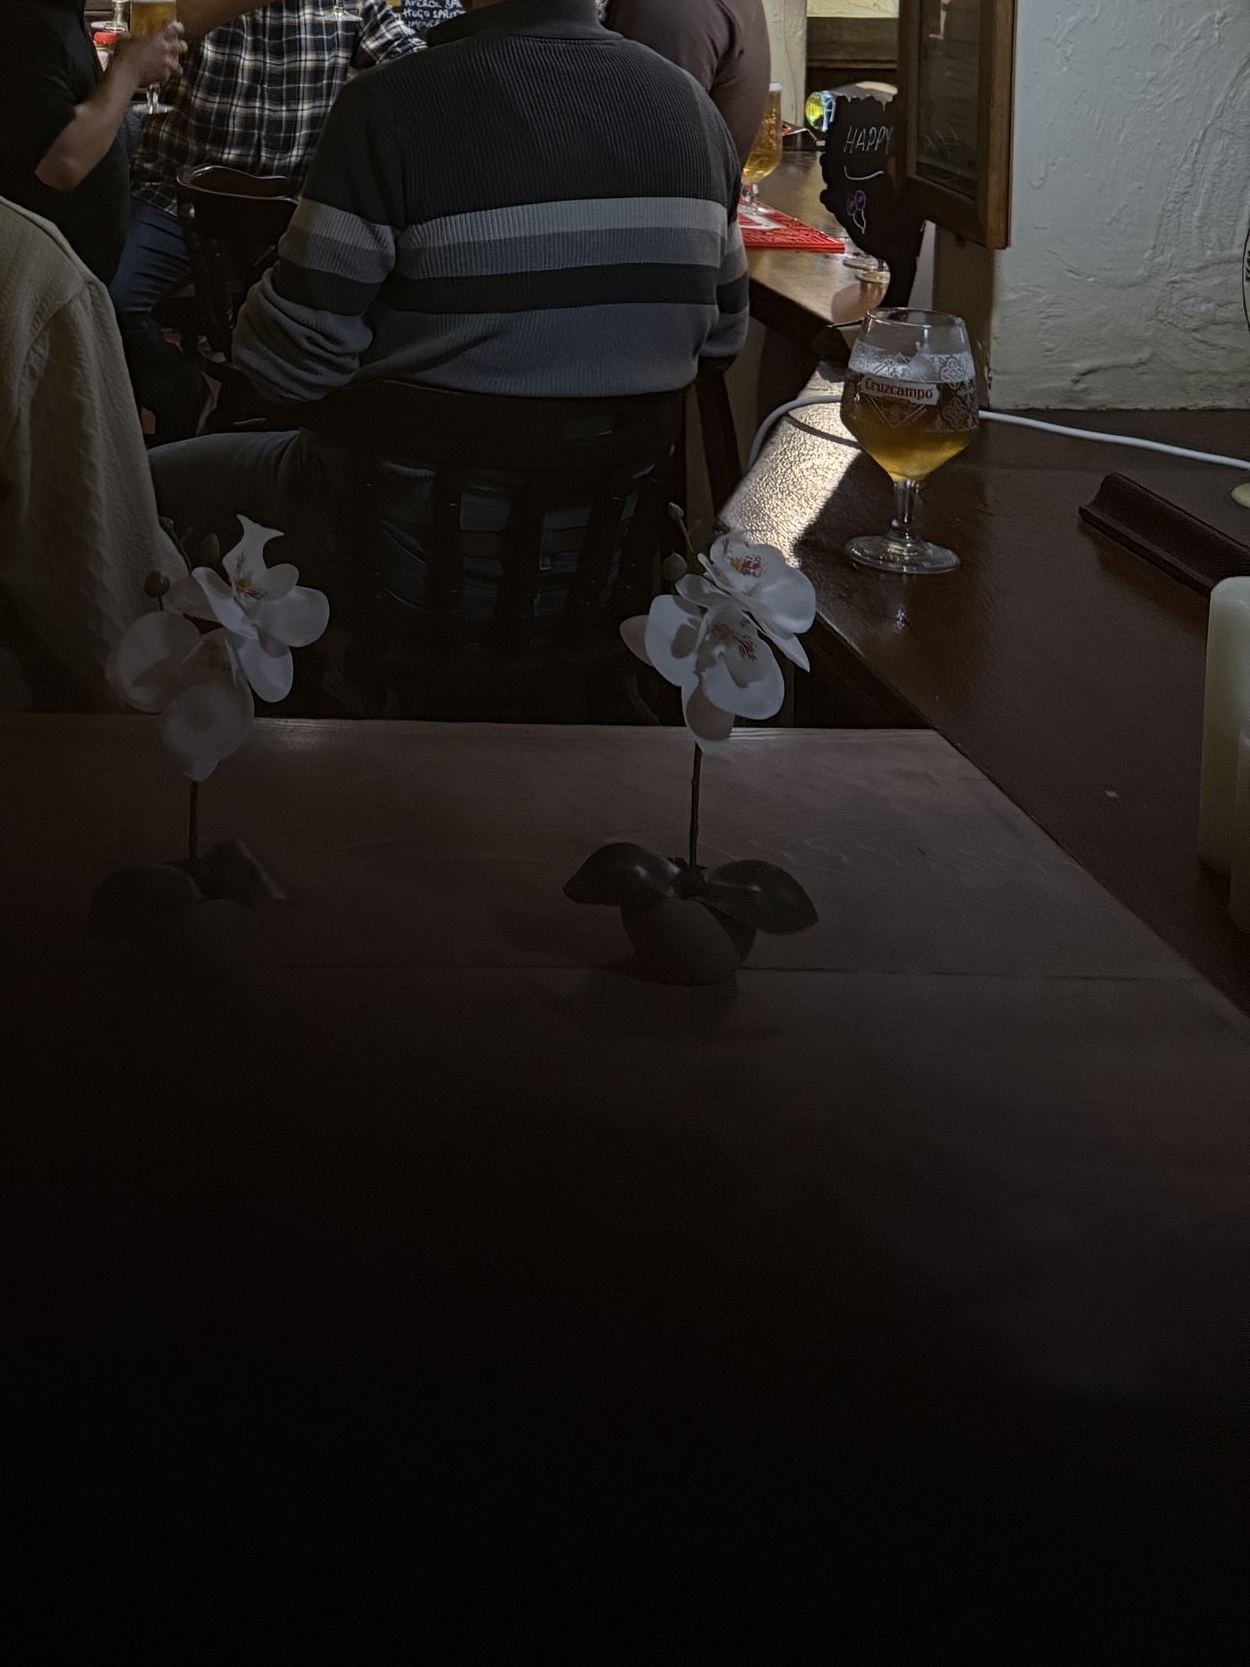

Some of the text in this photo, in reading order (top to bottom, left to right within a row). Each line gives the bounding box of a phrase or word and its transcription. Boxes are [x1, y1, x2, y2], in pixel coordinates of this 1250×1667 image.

[403, 9, 430, 19] HUGO
[844, 125, 894, 155] HAPPY
[865, 377, 934, 400] Cruzcampo
